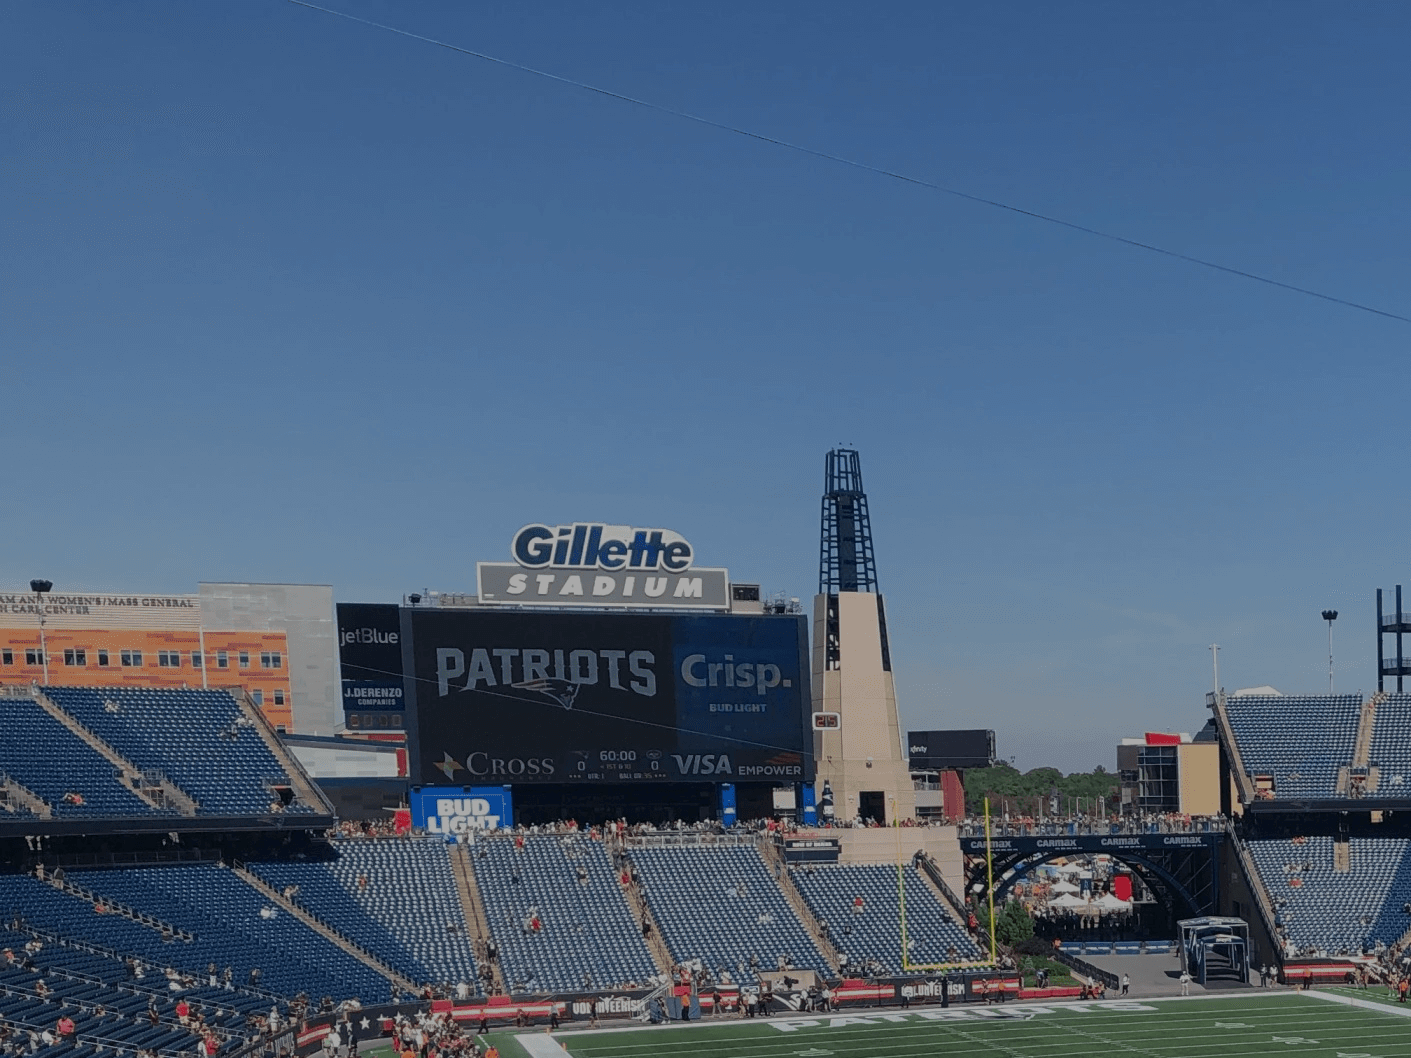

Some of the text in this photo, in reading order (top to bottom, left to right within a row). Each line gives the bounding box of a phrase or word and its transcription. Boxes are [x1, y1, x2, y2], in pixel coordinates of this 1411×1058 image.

[514, 525, 693, 573] Gillette
[506, 572, 703, 599] STADIUM
[44, 605, 90, 615] CENTER
[141, 597, 194, 608] GENERAL
[340, 627, 399, 647] jetBlue
[435, 647, 658, 698] PATRIOTS
[680, 652, 792, 693] Crisp.
[344, 687, 403, 698] J.DERENZO
[709, 703, 768, 713] BUD LIGHT
[599, 750, 637, 761] 60:00
[670, 754, 733, 775] VISA
[577, 760, 586, 771] 0
[650, 760, 659, 771] 0
[738, 765, 801, 776] EMPOWER
[436, 798, 491, 817] BUD
[427, 815, 501, 834] LIGHT
[768, 1002, 1159, 1033] PATRIOTS
